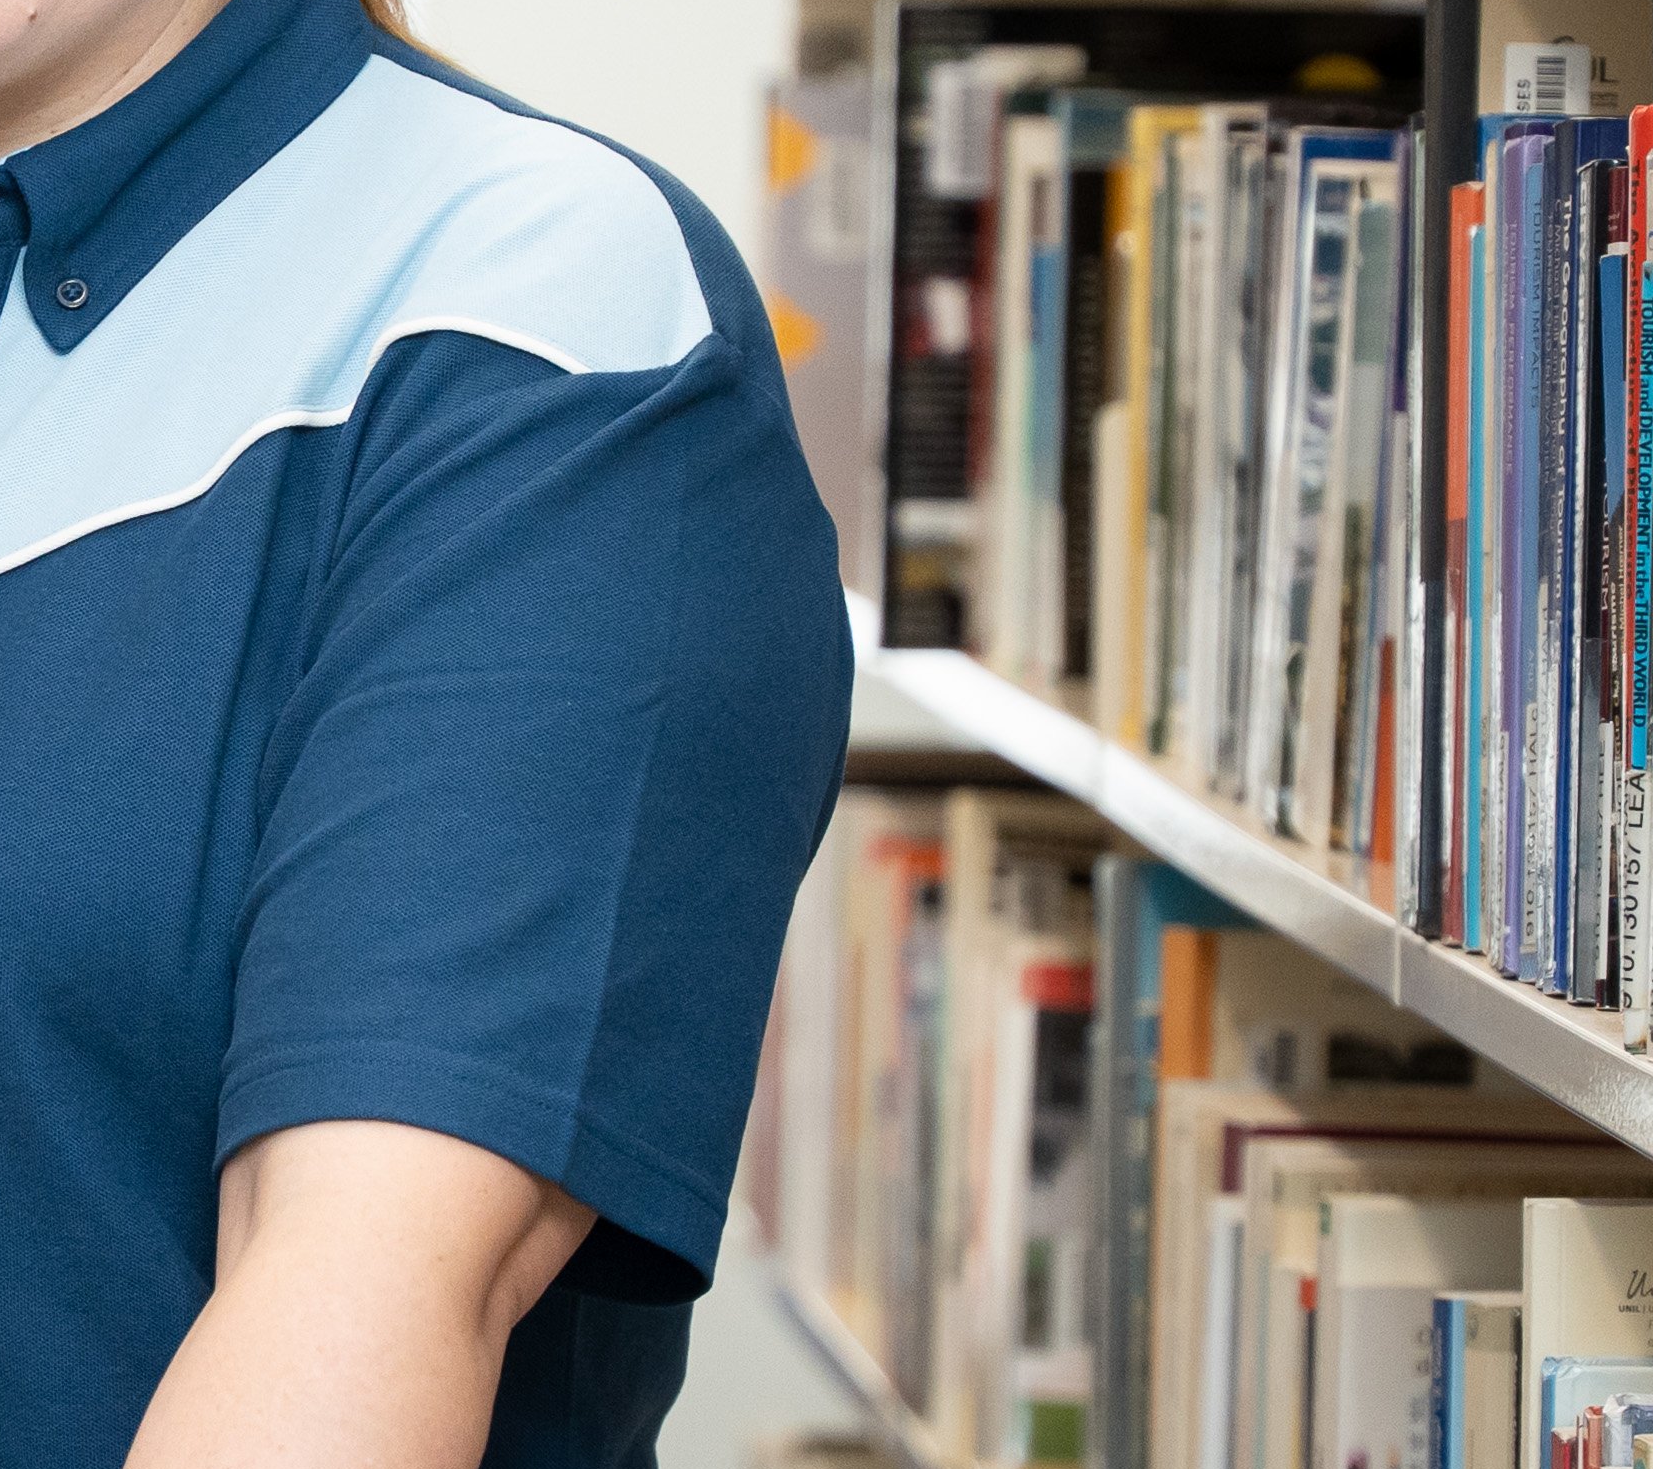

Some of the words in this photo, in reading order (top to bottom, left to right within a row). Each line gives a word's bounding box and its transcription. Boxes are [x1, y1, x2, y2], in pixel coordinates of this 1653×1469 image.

[1561, 194, 1572, 251] The
[1629, 159, 1640, 217] The
[1529, 199, 1543, 300] TOURISM
[1552, 223, 1562, 299] Michael
[1555, 259, 1571, 435] Geography
[1625, 228, 1639, 419] Architecture
[1528, 309, 1541, 409] IMPACTS
[1638, 378, 1653, 413] and
[1556, 445, 1566, 477] of
[1634, 415, 1653, 550] DEVELOPMENT
[1553, 487, 1565, 599] Tourism
[1623, 465, 1636, 601] Pleasure
[1635, 551, 1649, 570] in
[1634, 574, 1648, 599] the
[1633, 601, 1648, 656] THIRD
[1631, 658, 1646, 728] WORLD
[1626, 772, 1646, 828] LEA
[1621, 840, 1642, 1008] 910.130157
[1618, 1305, 1641, 1313] UNIL
